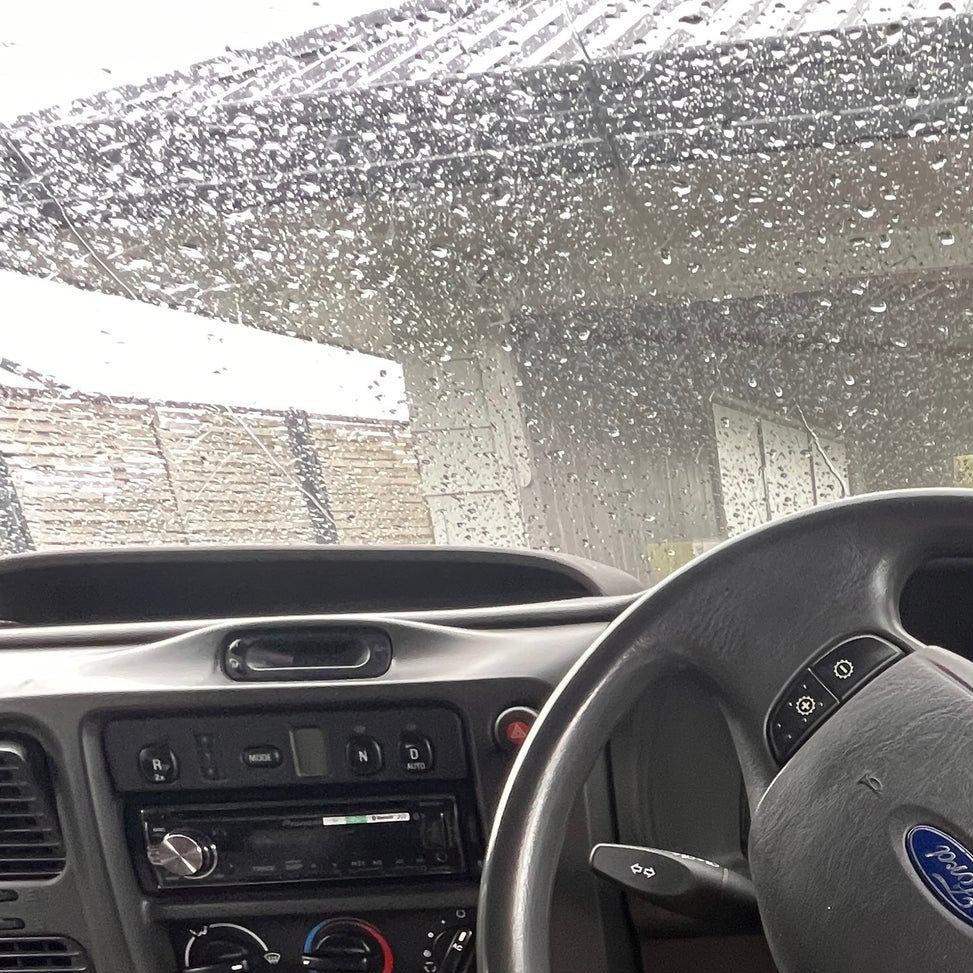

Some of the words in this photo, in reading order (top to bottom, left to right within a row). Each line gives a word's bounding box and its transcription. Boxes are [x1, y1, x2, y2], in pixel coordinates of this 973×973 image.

[249, 754, 272, 762] MODE
[358, 750, 368, 762] N
[410, 748, 419, 760] D
[152, 758, 163, 770] R
[407, 762, 426, 770] AUTO
